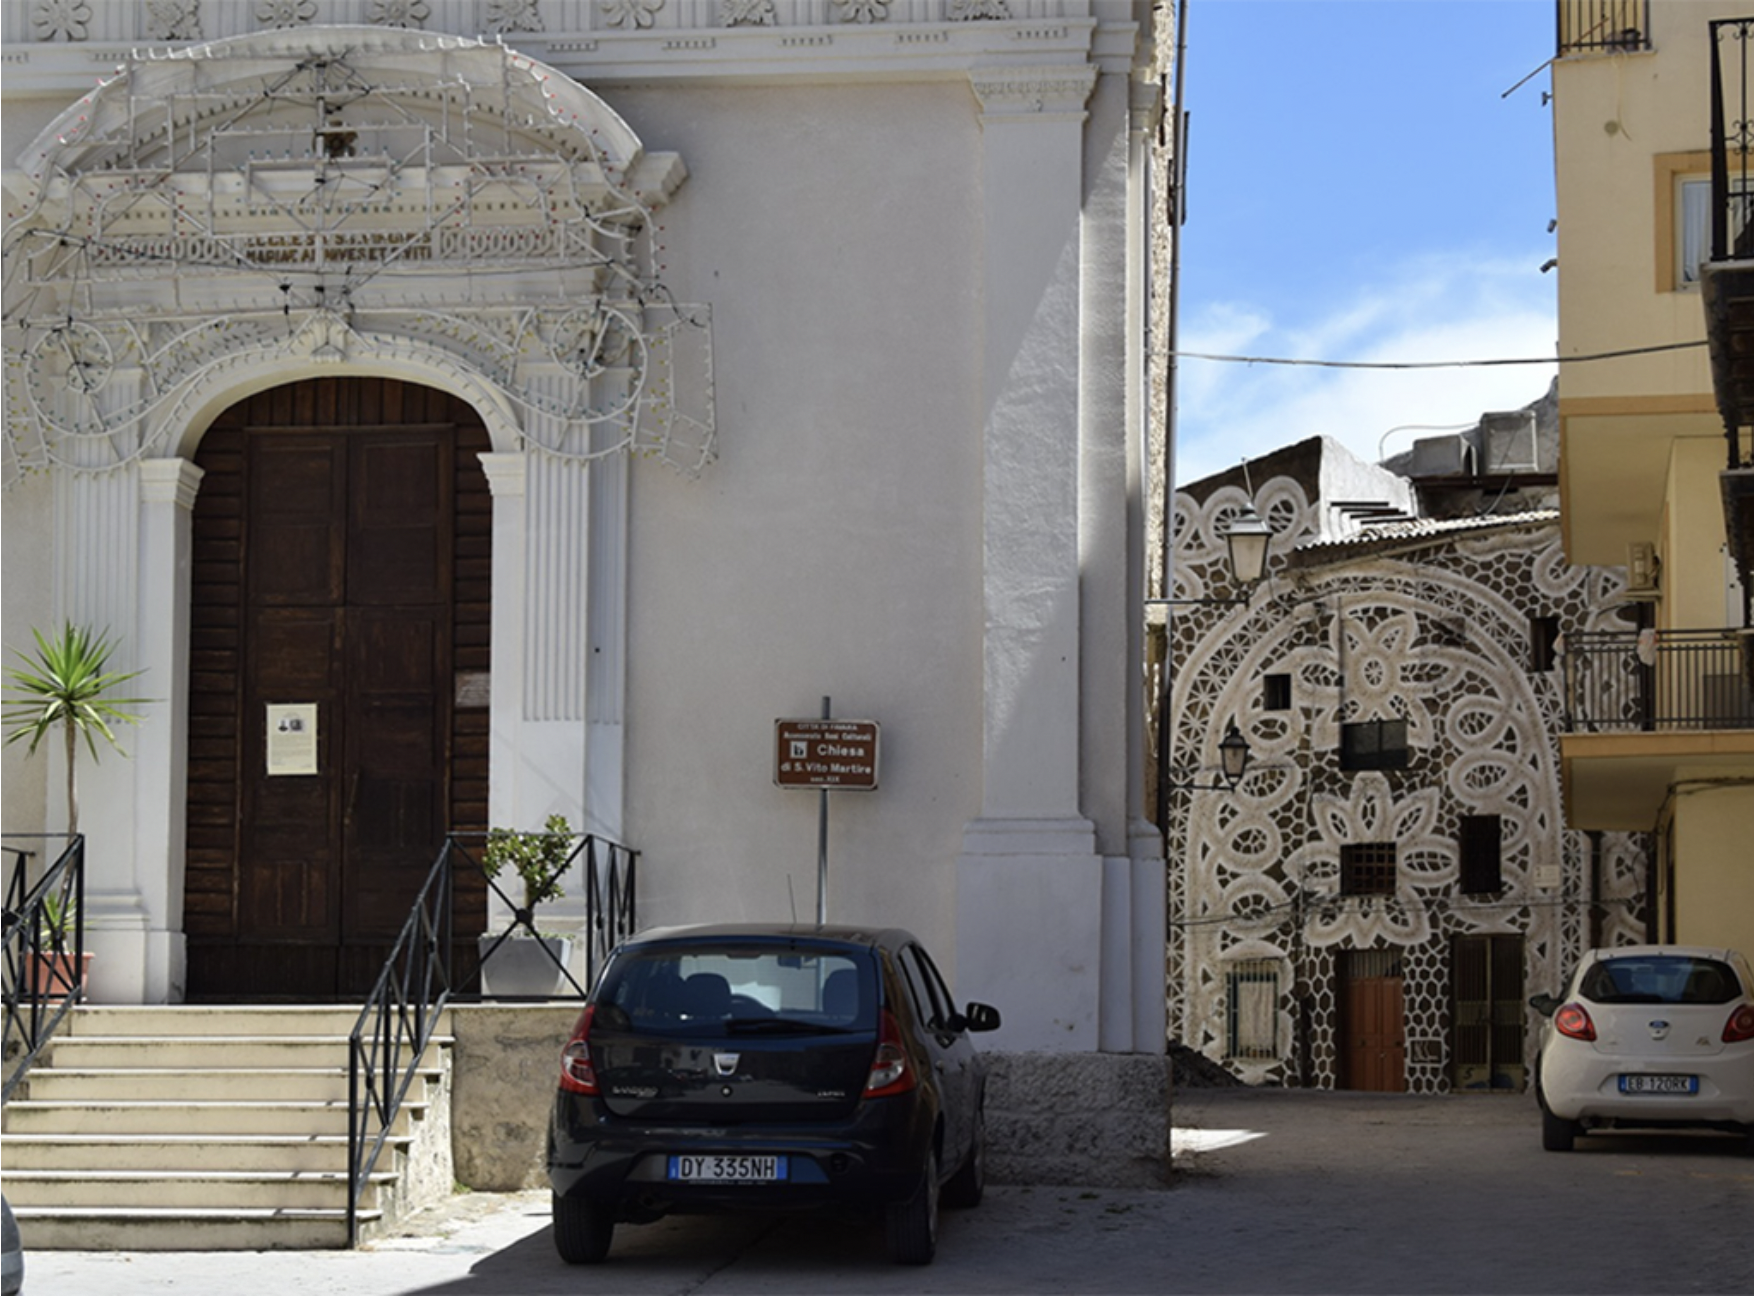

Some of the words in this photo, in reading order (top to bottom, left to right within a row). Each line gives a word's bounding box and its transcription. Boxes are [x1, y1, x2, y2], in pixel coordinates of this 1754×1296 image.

[817, 744, 864, 757] Chiesa
[781, 761, 791, 772] di
[805, 763, 828, 773] Vito
[830, 763, 871, 775] Martire
[681, 1158, 705, 1177] DY
[713, 1157, 776, 1177] 335NH
